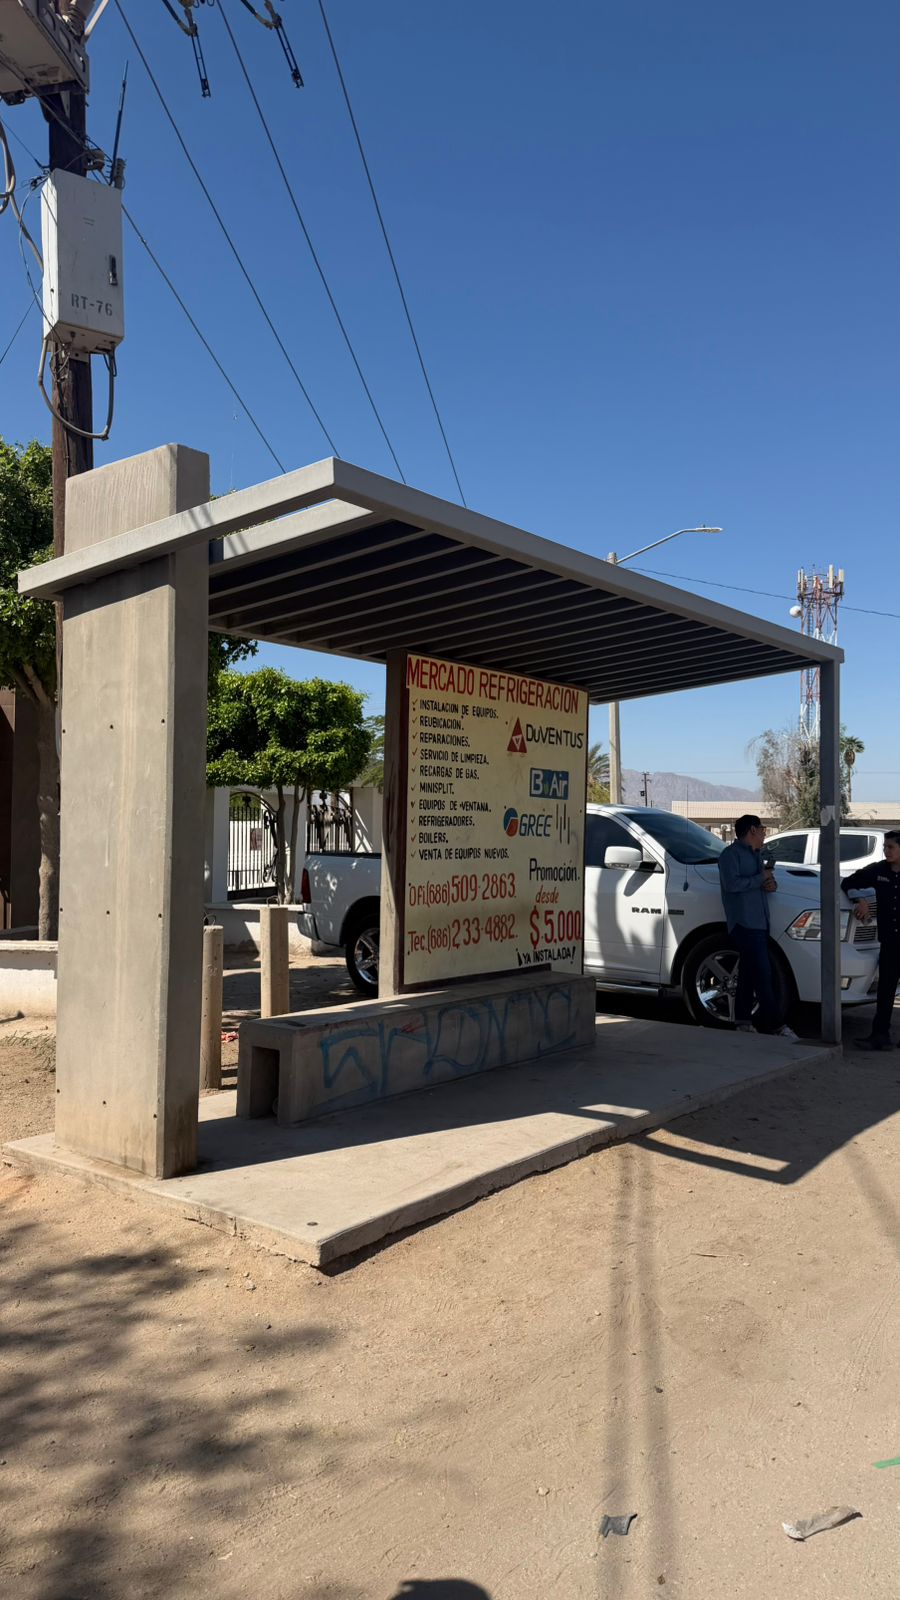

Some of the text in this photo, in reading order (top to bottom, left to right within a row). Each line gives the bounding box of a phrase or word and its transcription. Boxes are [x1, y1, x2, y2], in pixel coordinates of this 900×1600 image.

[71, 292, 113, 317] RT-76
[407, 656, 580, 715] MERCADO REFRIGERACION
[419, 699, 499, 719] INSTALACION DE EQUIPOS.
[419, 715, 465, 731] REUBICACION.
[419, 731, 471, 748] REPARACIONES.
[420, 748, 449, 761] SERVICIO
[451, 751, 459, 763] DE
[419, 765, 453, 778] RECARGAS
[455, 767, 463, 779] DE
[419, 781, 455, 795] MINISPLIT.
[418, 798, 446, 812] EQUIPOS
[449, 800, 458, 811] DE
[518, 813, 553, 838] GREE
[418, 831, 449, 844] BOILERS.
[418, 848, 443, 861] VENTA
[444, 848, 454, 860] DE
[454, 847, 482, 860] EQUIPOS
[535, 884, 561, 905] desde
[631, 906, 662, 915] RAM
